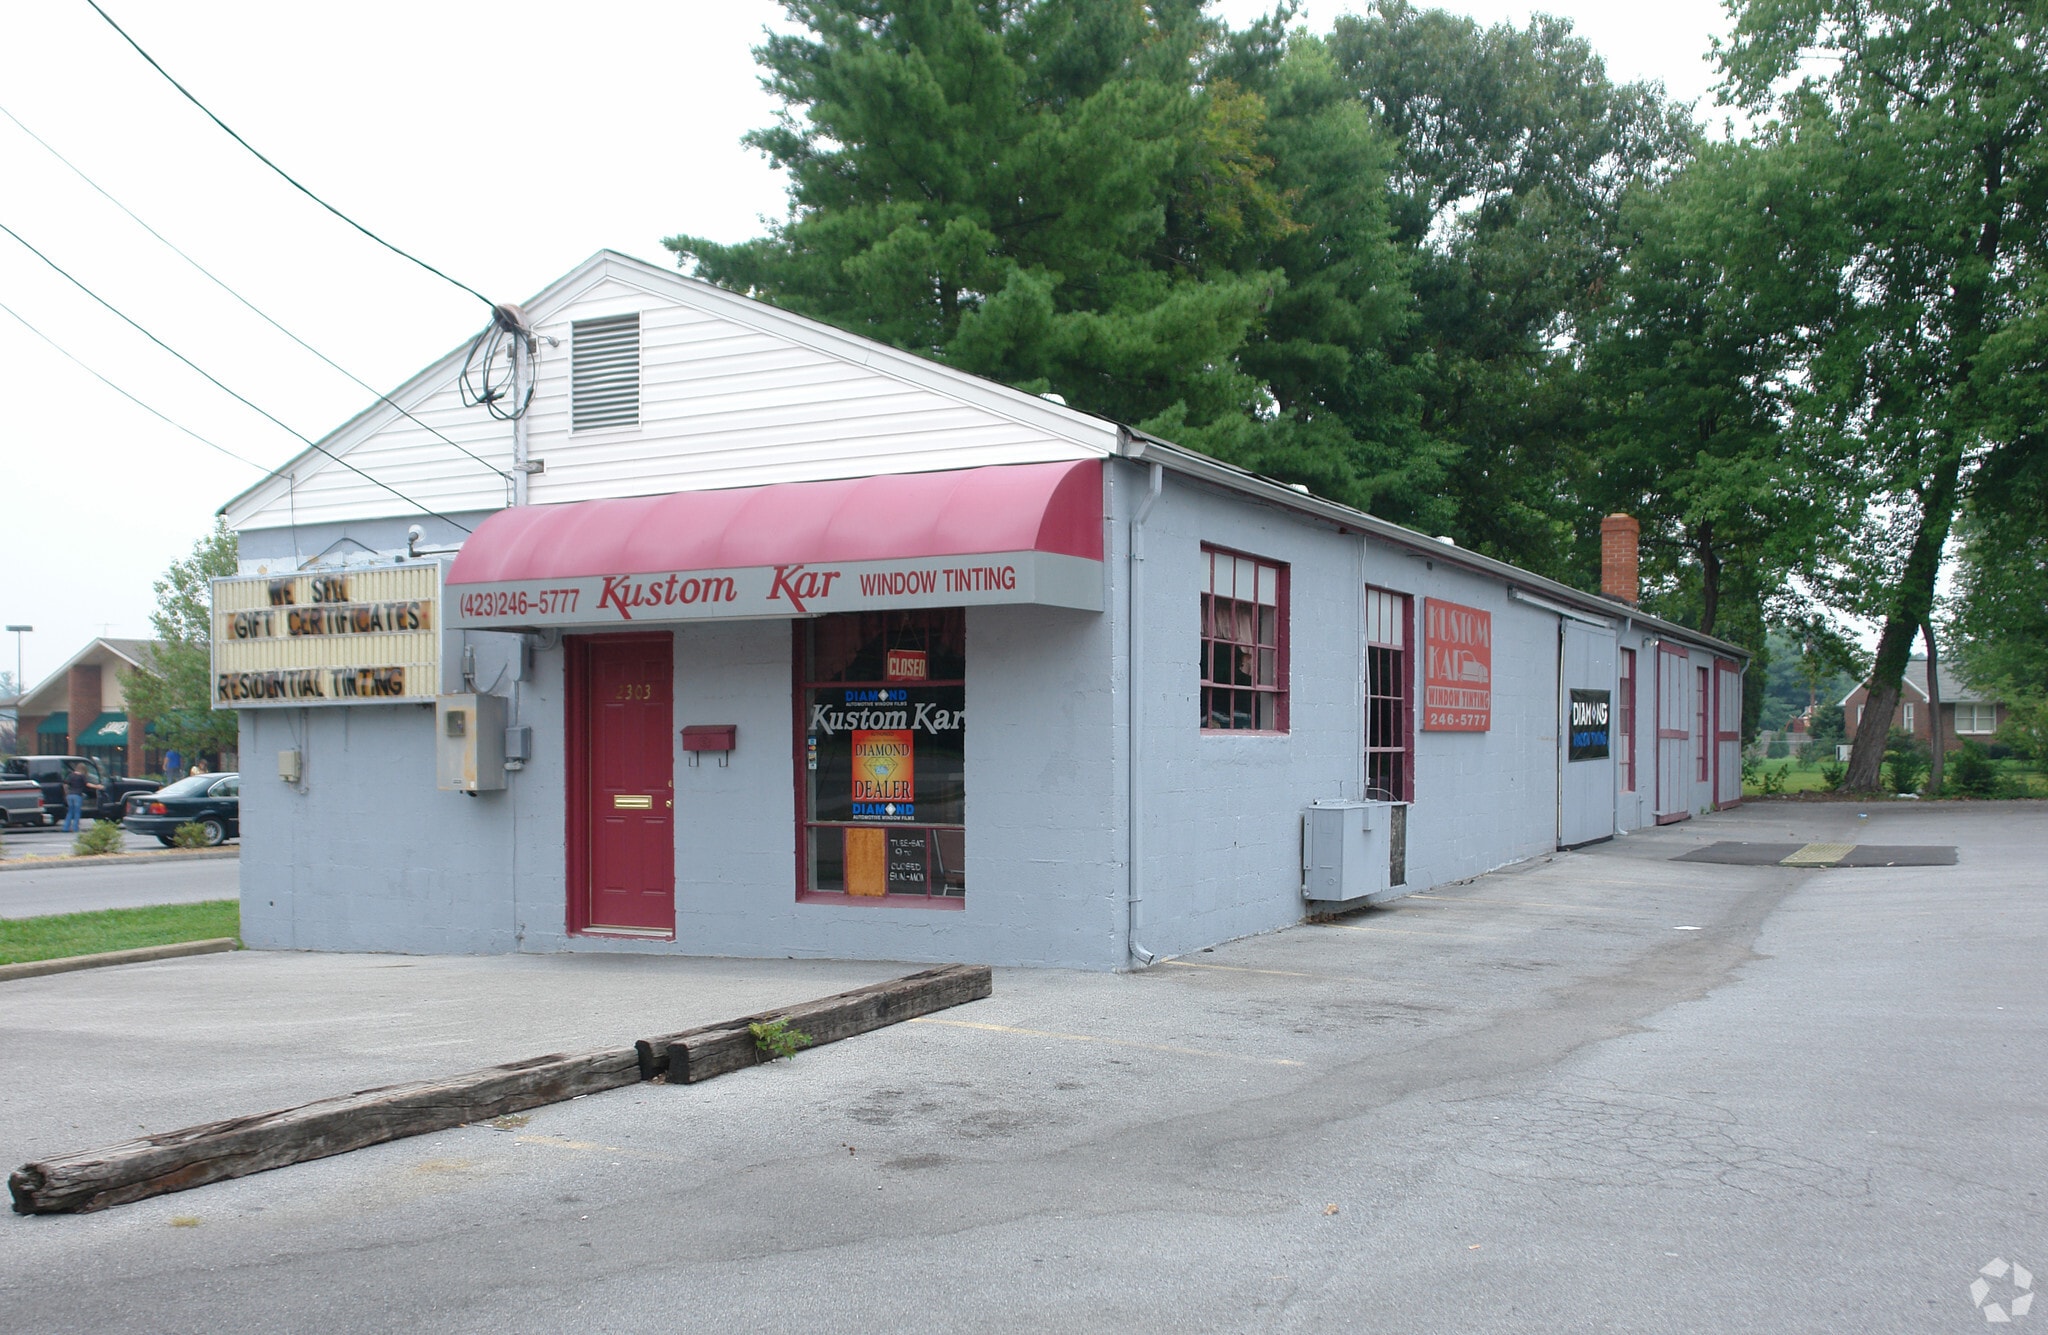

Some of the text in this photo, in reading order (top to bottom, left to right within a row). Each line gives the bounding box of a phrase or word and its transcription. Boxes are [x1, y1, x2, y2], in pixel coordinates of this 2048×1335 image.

[460, 565, 1016, 620] (423)246-5777 Kustom Kar WINDOW TINTING
[234, 601, 421, 639] GIFT CERTIFICATES
[1428, 605, 1489, 648] KUSTOM
[889, 657, 926, 677] CLOSED
[217, 668, 325, 701] RESIDENTIAL
[808, 703, 966, 735] Kustom Kar
[855, 743, 911, 758] DIAMOND
[855, 780, 913, 800] DEALER
[890, 862, 922, 871] CLOSED
